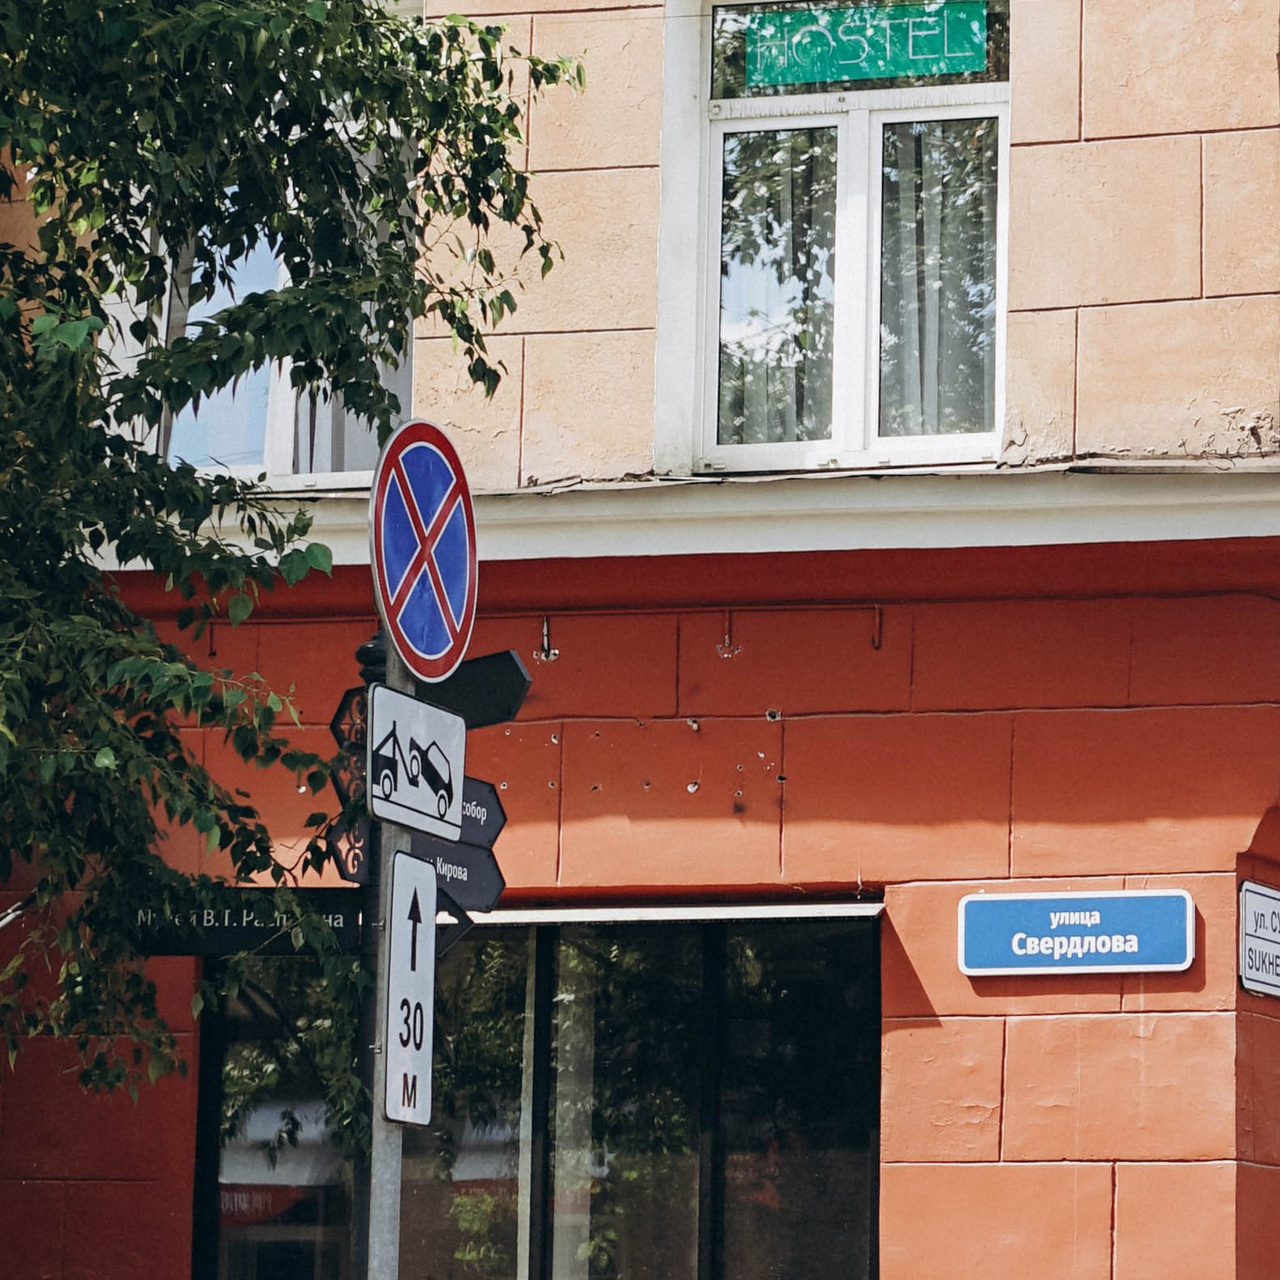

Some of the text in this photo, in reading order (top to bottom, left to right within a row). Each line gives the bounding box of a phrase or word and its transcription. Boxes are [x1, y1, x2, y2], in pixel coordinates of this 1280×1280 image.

[756, 9, 975, 72] HOSTEL
[436, 856, 468, 882] Кирова
[1050, 910, 1101, 929] улица
[1253, 911, 1268, 933] ул.
[1011, 932, 1139, 960] Свердлова
[399, 997, 424, 1051] 30
